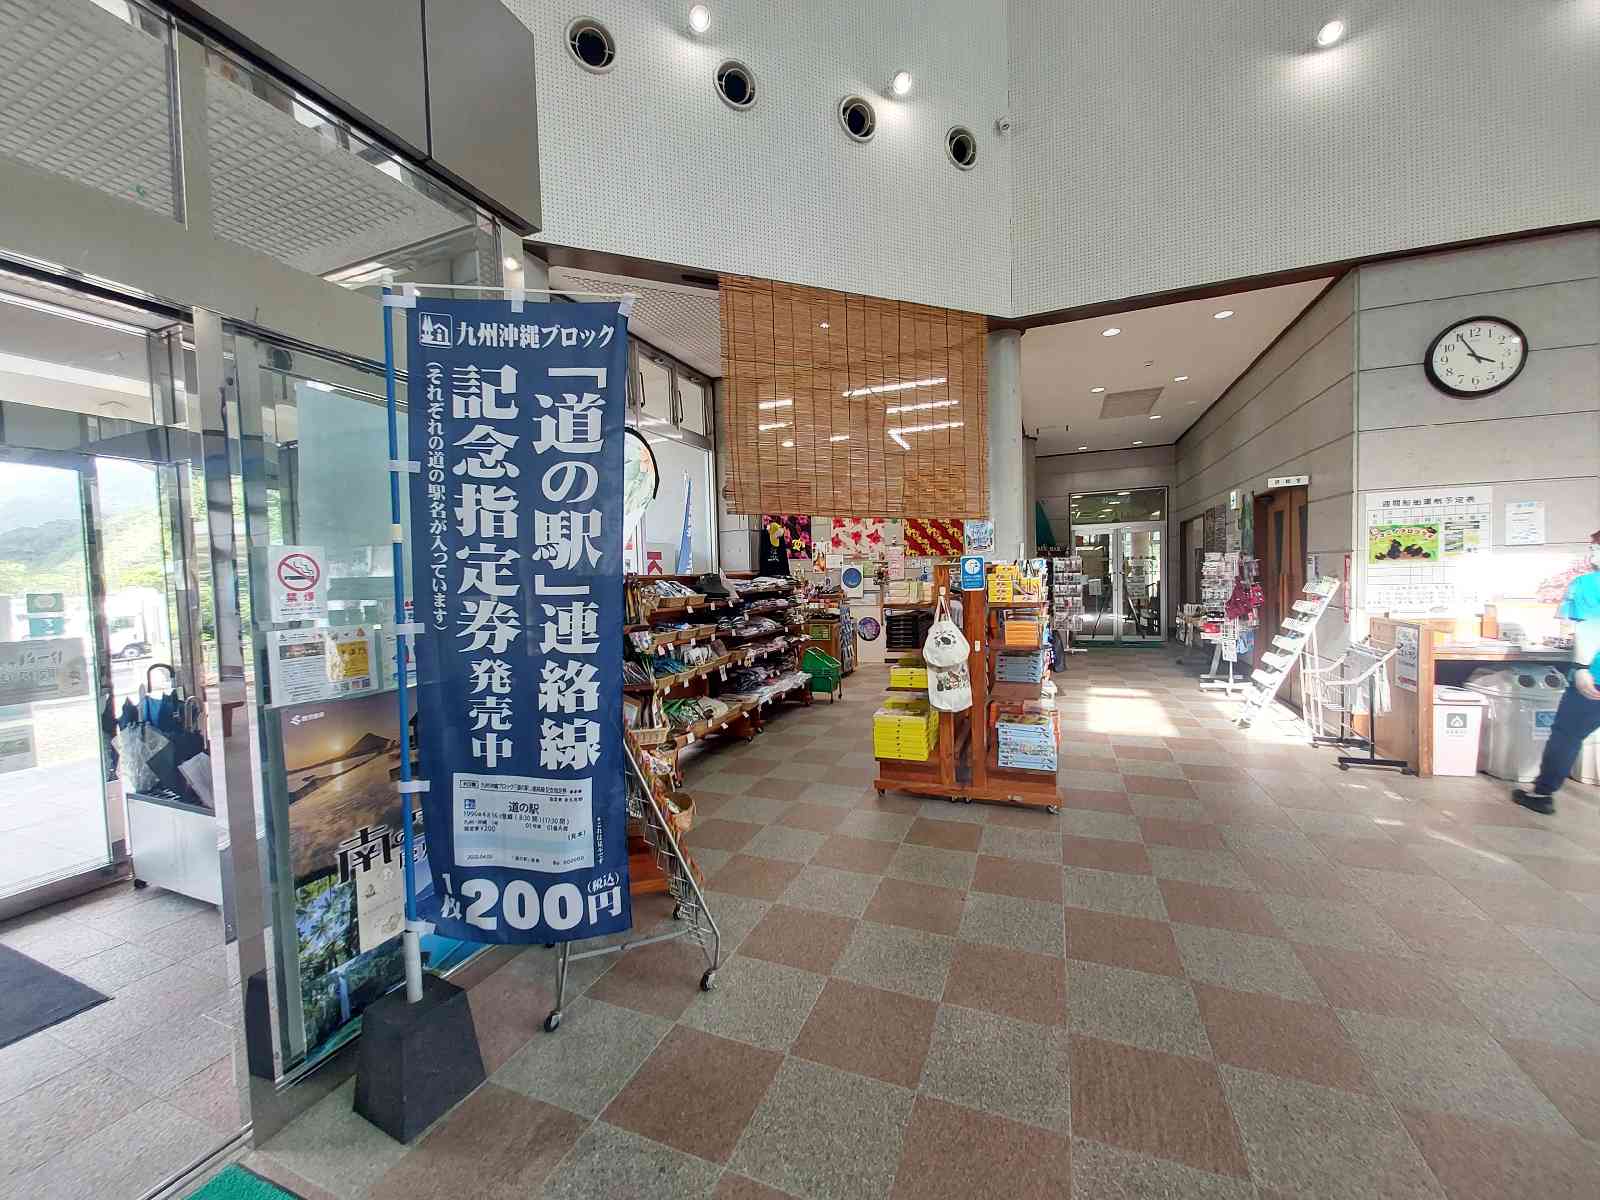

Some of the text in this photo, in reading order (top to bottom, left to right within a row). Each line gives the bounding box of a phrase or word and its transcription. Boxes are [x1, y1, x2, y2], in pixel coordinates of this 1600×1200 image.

[456, 321, 615, 349] 九州沖縄ブロック
[508, 801, 540, 815] 道の駅
